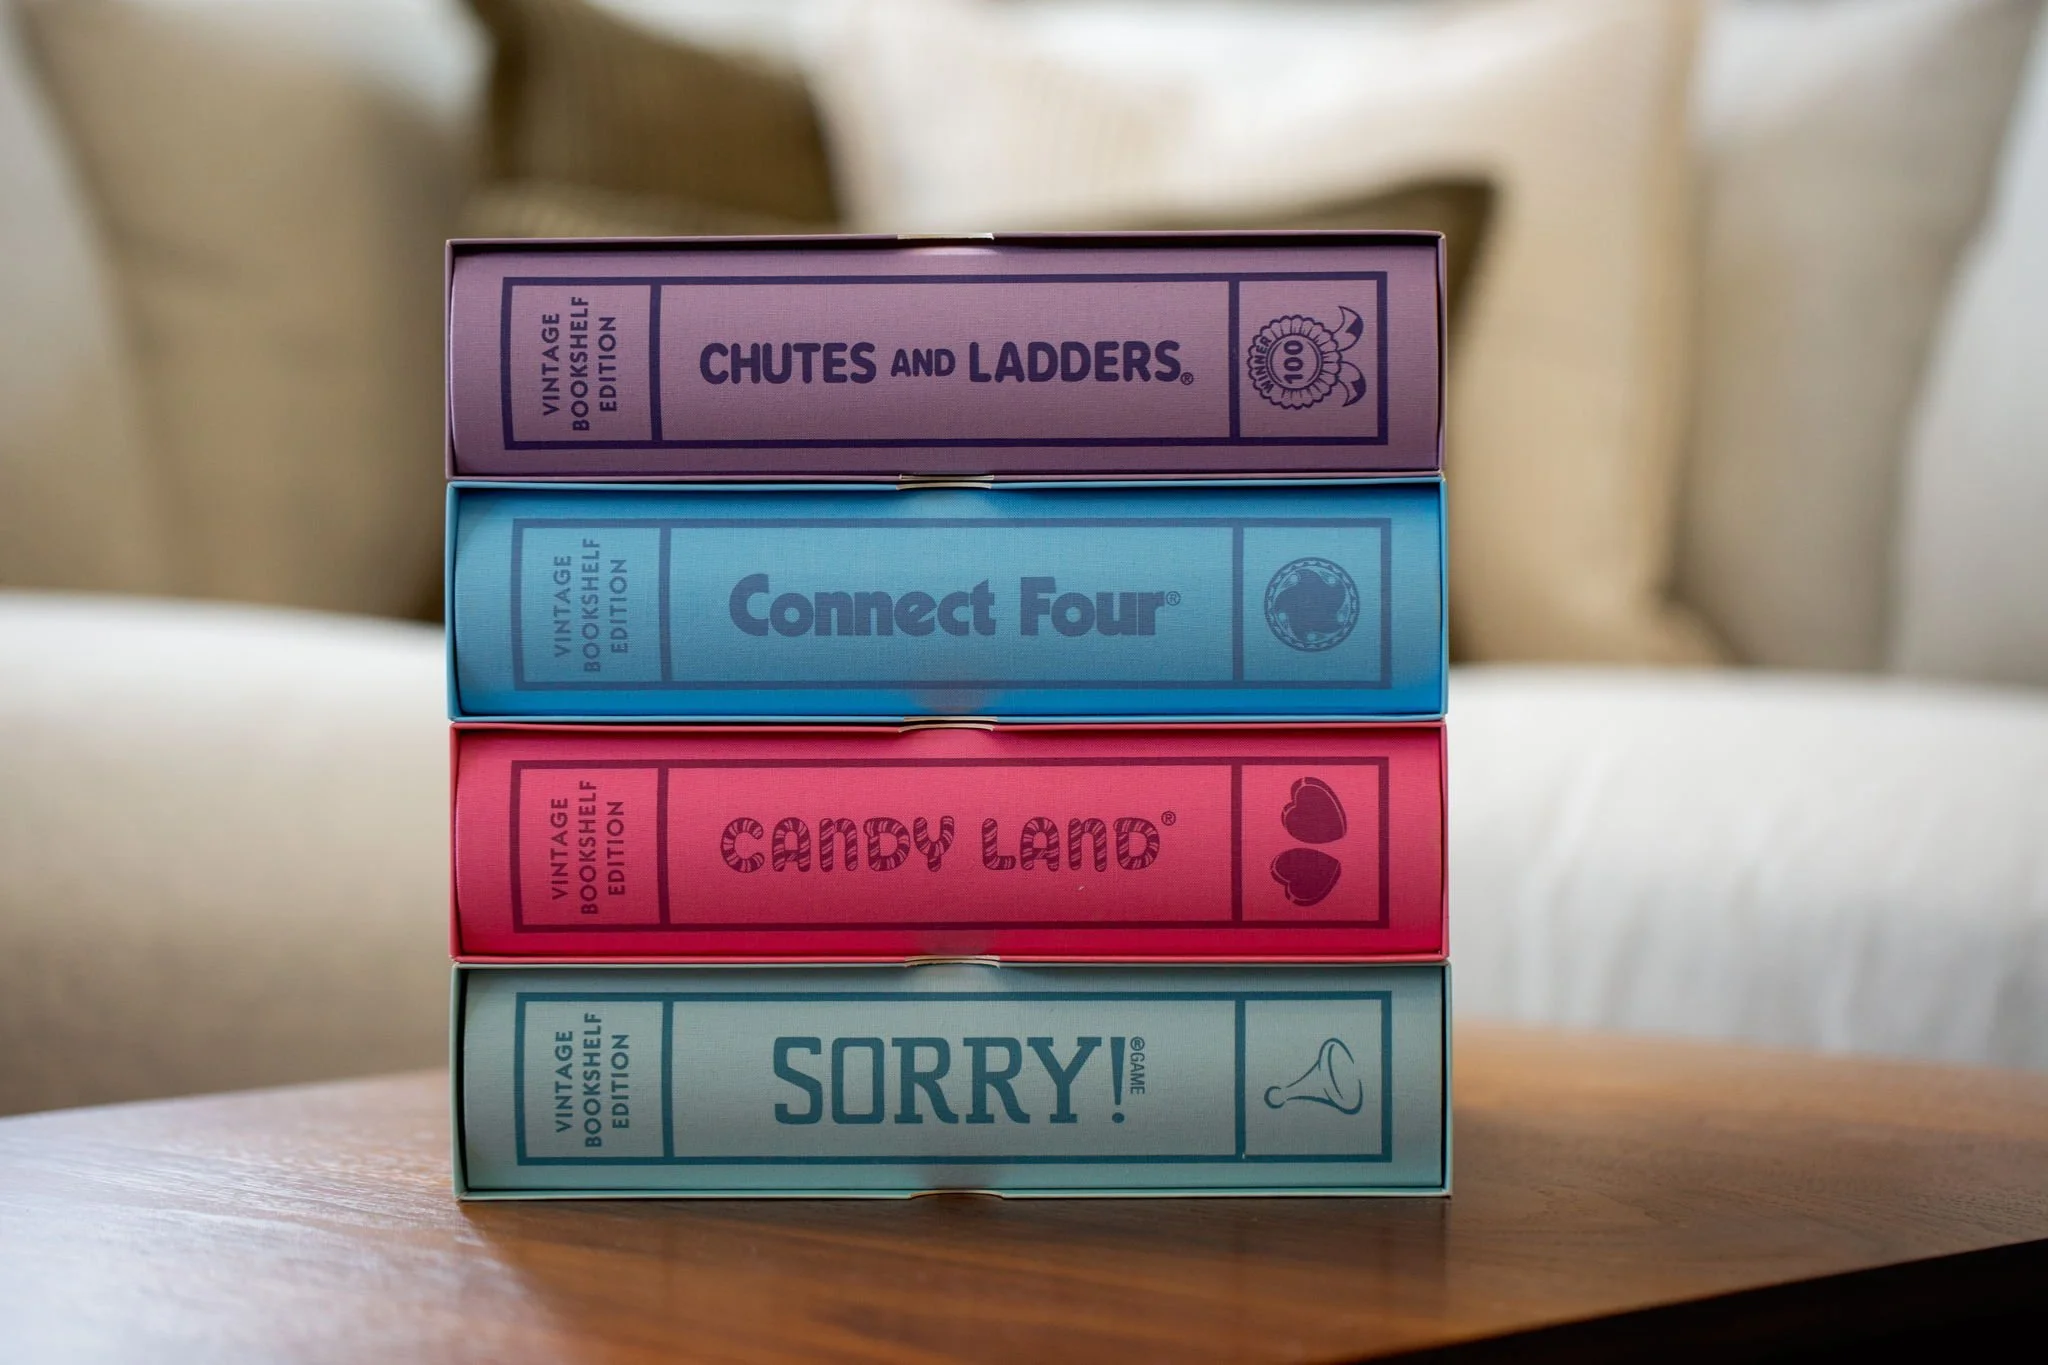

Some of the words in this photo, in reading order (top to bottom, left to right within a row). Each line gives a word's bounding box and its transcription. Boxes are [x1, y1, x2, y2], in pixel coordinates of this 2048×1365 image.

[542, 312, 560, 416] VINTAGE
[571, 296, 590, 431] BOOKSHELF
[599, 316, 617, 412] EDITION
[700, 342, 876, 385] CHUTES
[890, 348, 956, 377] AND
[1254, 336, 1274, 393] WINNER
[1283, 340, 1303, 384] 100
[553, 555, 571, 658] VINTAGE
[583, 538, 601, 673] BOOKSHELF
[611, 559, 628, 654] EDITION
[729, 573, 996, 636] Connect
[551, 797, 568, 900] VINTAGE
[580, 780, 598, 915] BOOKSHELF
[607, 800, 625, 896] EDITION
[720, 816, 955, 873] CANDY
[555, 1030, 574, 1133] VINTAGE
[584, 1012, 603, 1148] BOOKSHELF
[612, 1033, 630, 1129] EDITION
[773, 1037, 1126, 1125] SORRY!
